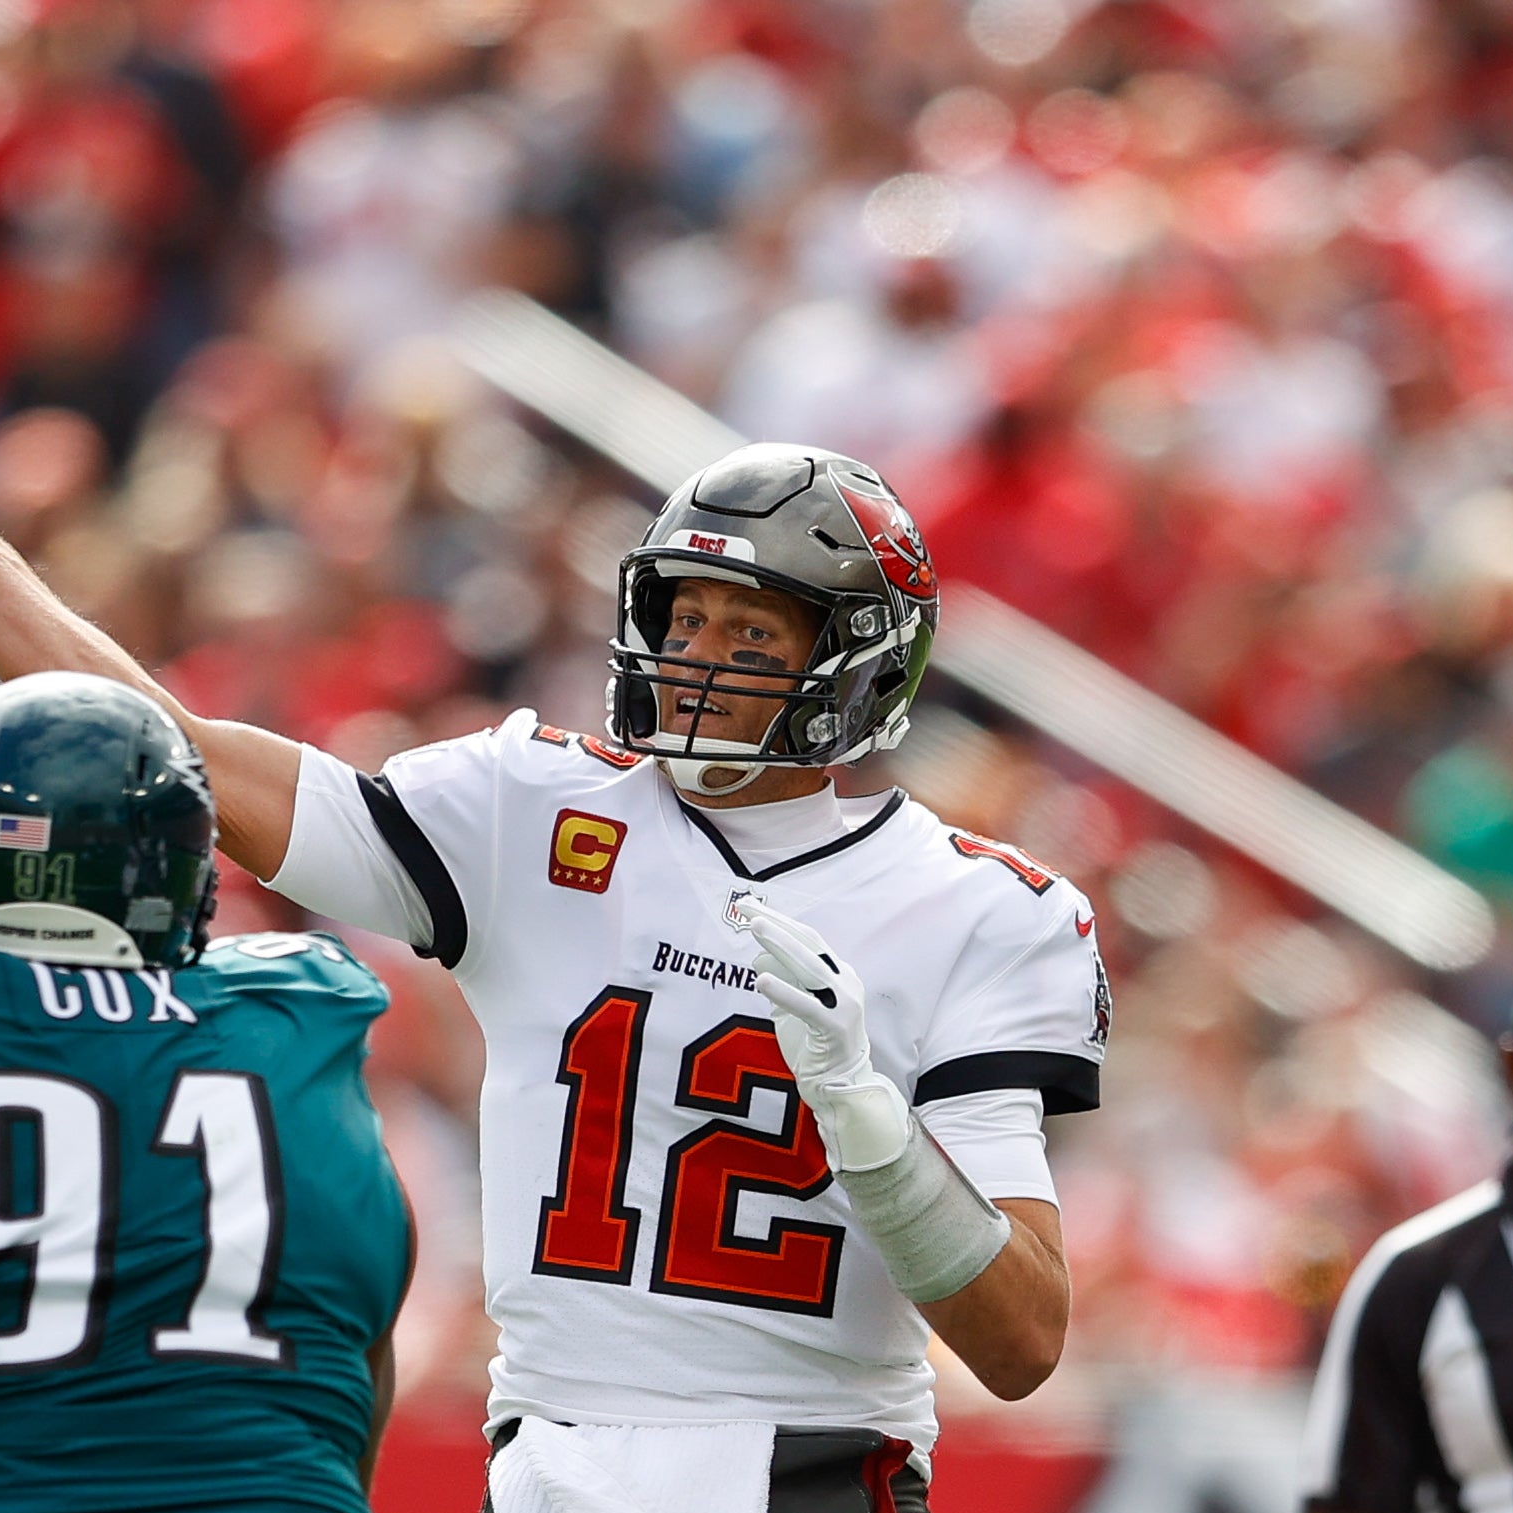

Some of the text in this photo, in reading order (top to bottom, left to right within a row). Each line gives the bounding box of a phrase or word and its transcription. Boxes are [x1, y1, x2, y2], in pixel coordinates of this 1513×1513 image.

[556, 816, 618, 872] C
[14, 851, 77, 904] 91
[28, 961, 199, 1024] COX
[652, 941, 763, 993] BUCCANE
[531, 984, 846, 1318] 12
